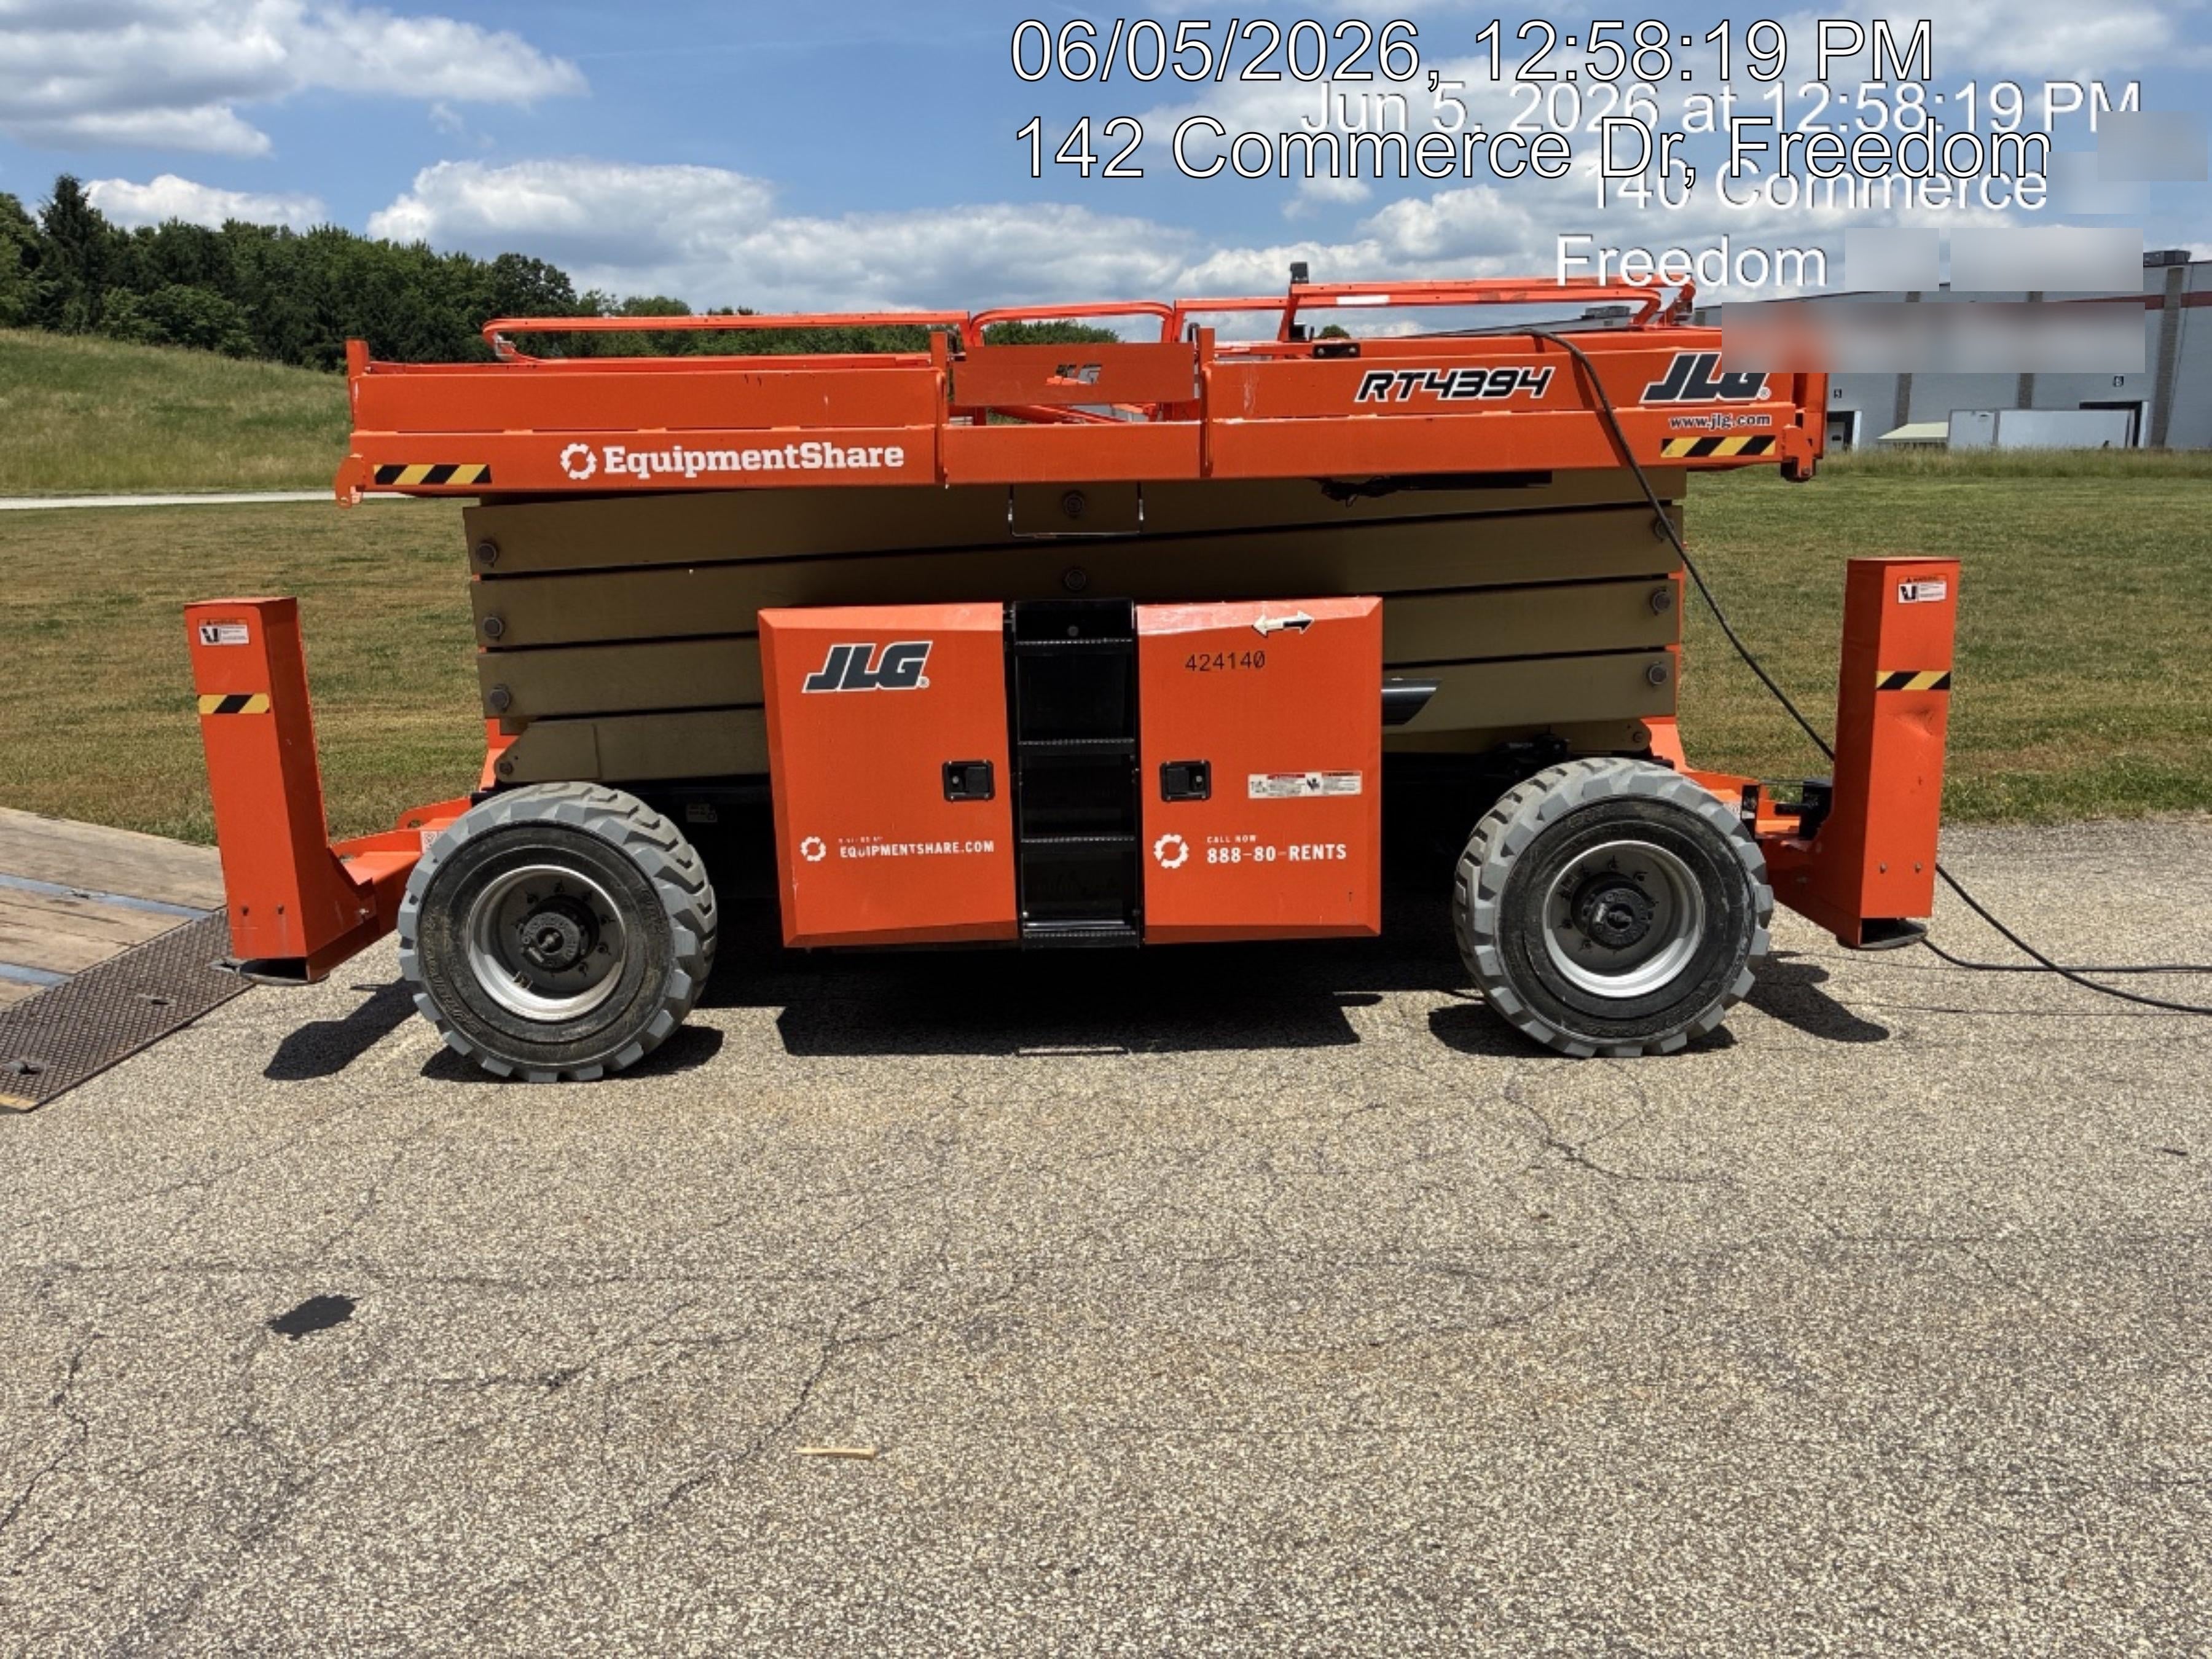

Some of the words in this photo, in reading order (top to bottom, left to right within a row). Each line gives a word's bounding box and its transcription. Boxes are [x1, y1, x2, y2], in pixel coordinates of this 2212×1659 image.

[1354, 366, 1556, 402] RT4394
[1669, 414, 1772, 431] www.jlg.com
[603, 442, 904, 479] EquipmentShare
[802, 640, 933, 693] JLG
[1185, 649, 1266, 672] 424140
[839, 840, 995, 858] EQUIPMENTSHARE.COM
[1234, 834, 1257, 843] NOW
[1207, 843, 1347, 864] 888-80-RENTS
